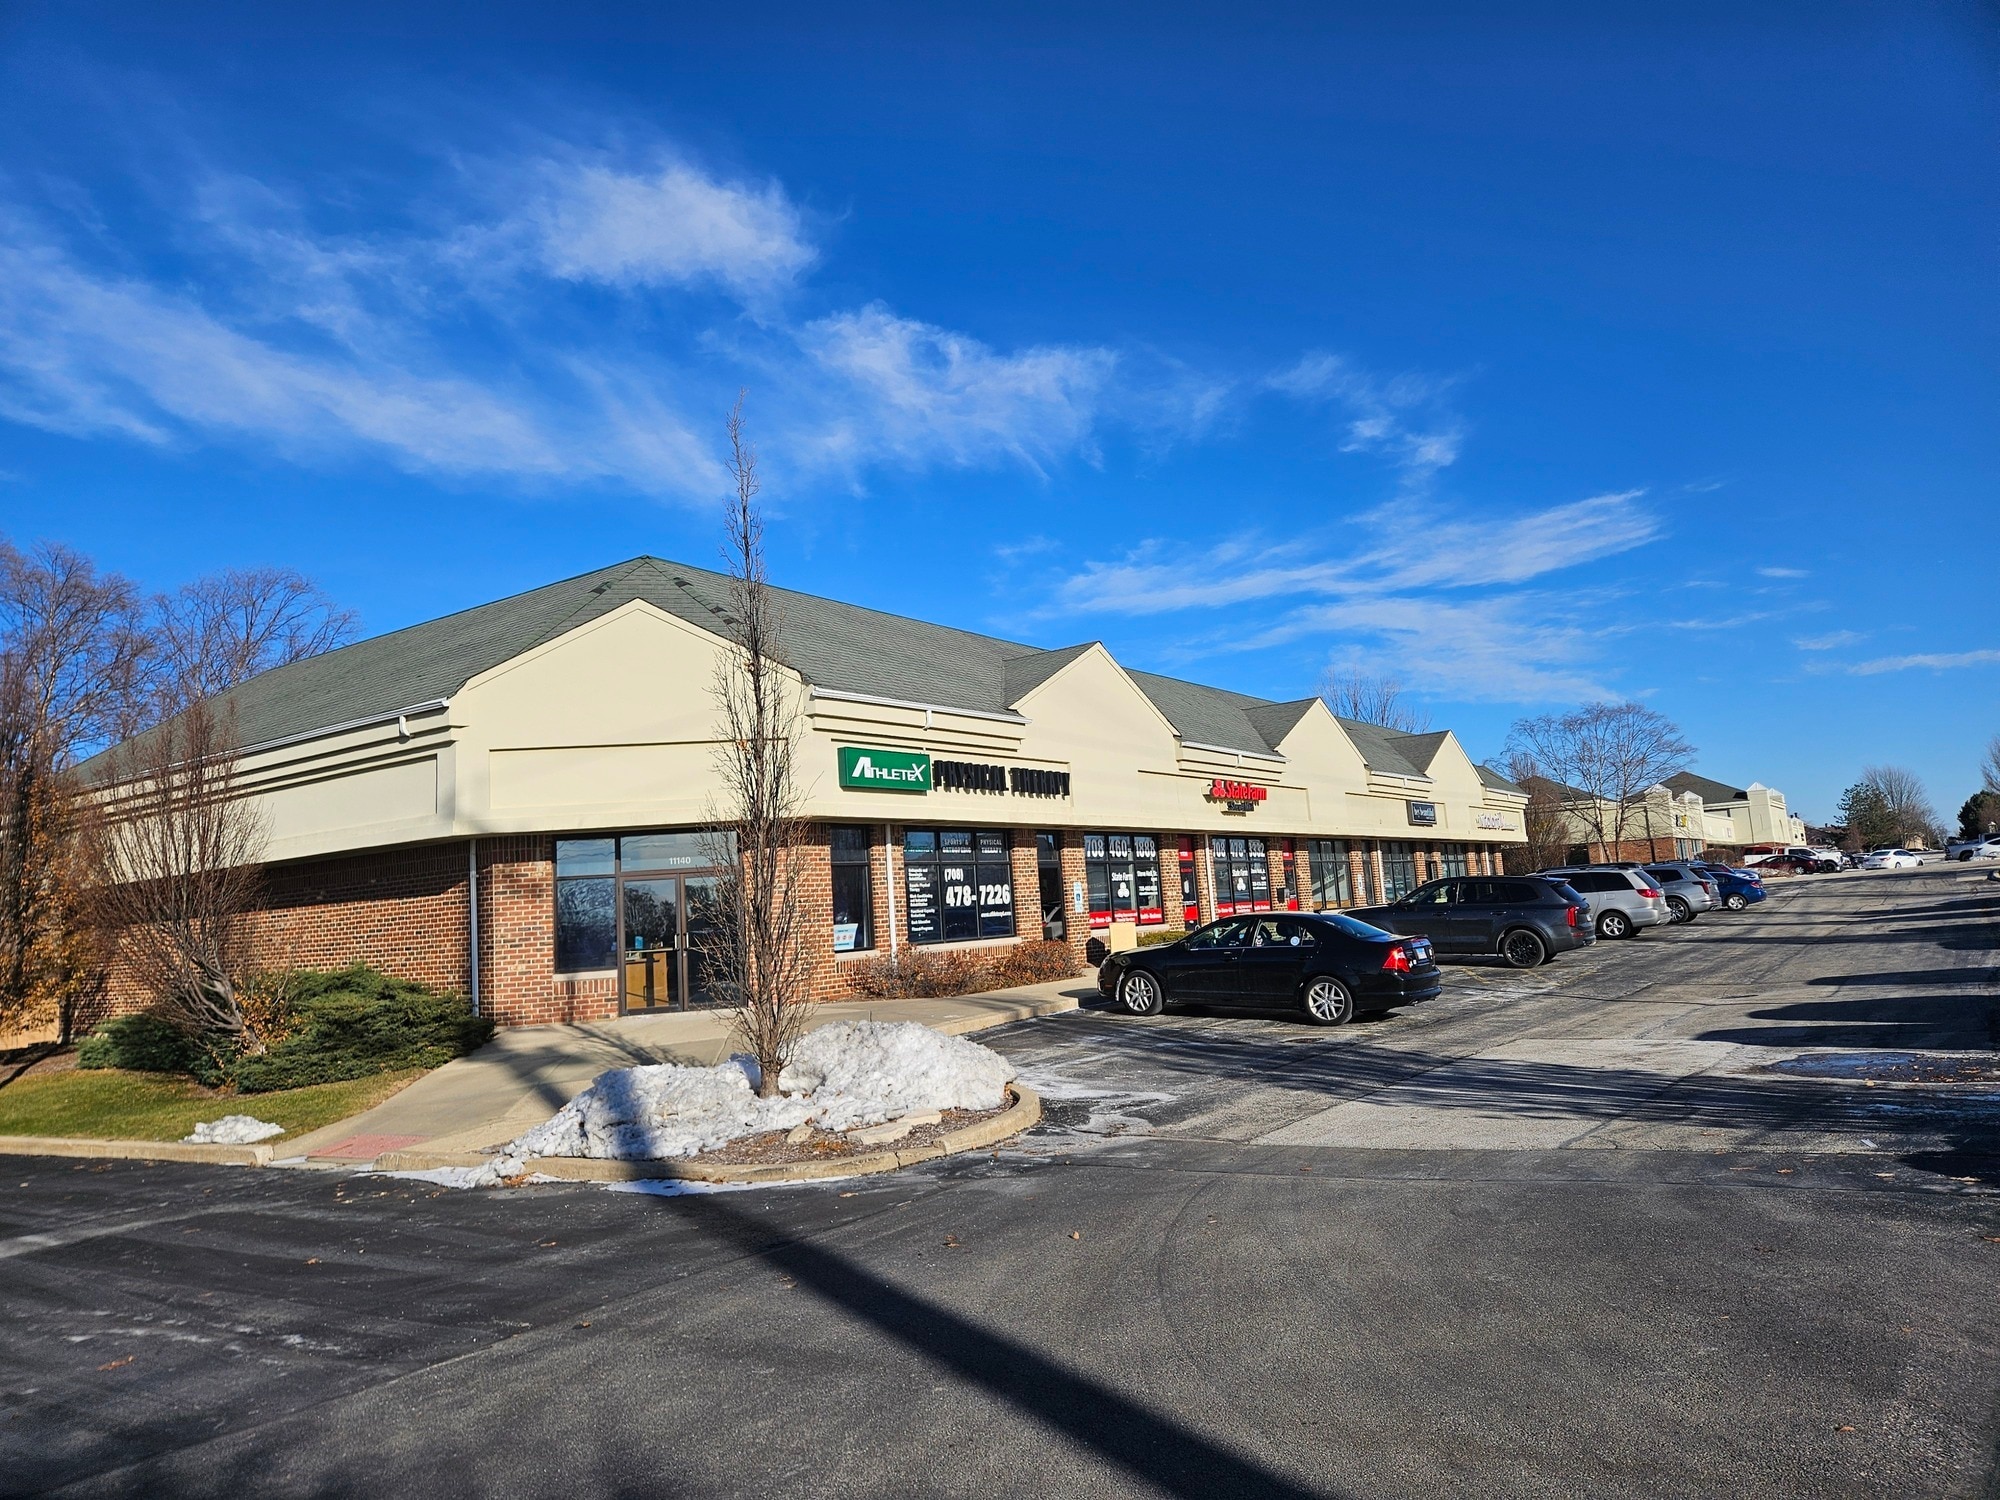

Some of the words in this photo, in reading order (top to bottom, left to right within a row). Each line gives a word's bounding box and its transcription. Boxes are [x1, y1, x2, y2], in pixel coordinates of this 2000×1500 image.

[932, 760, 1009, 793] PHYSICAL
[1009, 767, 1070, 796] THERAPY
[1086, 839, 1105, 858] 708
[1135, 839, 1156, 858] 1888
[1212, 841, 1226, 858] 708
[669, 856, 691, 865] 11140
[944, 868, 964, 882] (708)
[1111, 872, 1122, 881] State
[1122, 872, 1133, 881] Farm
[979, 883, 1011, 905] 7226
